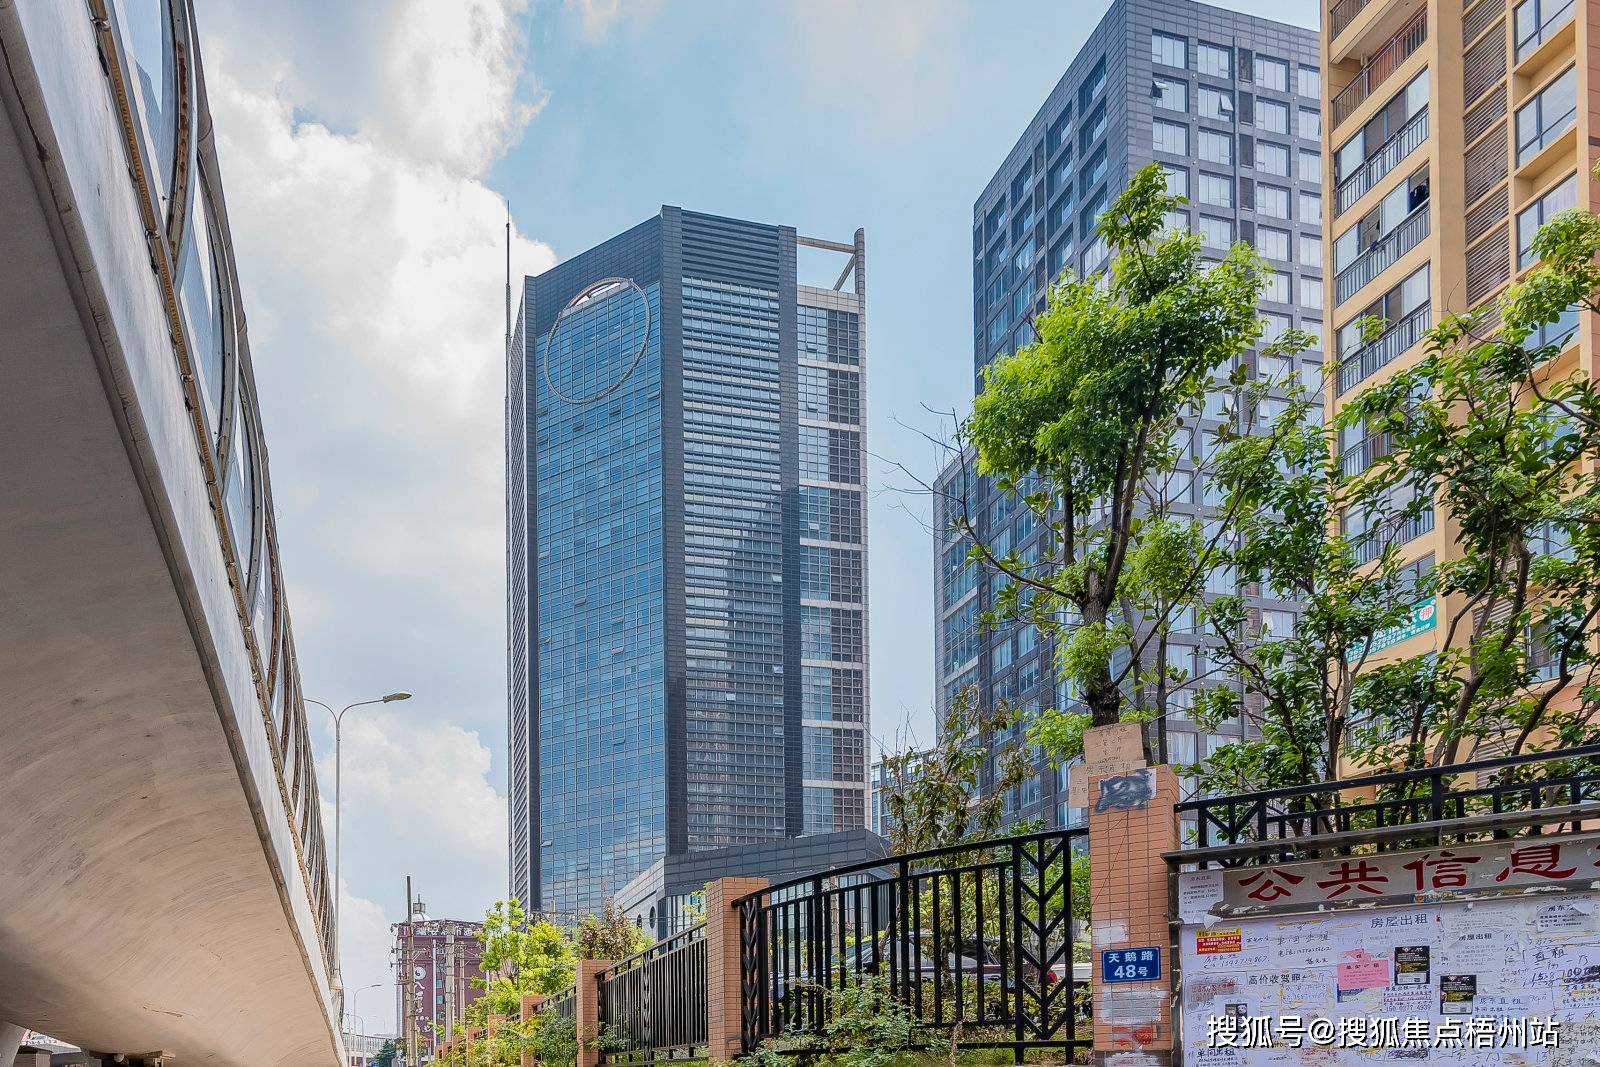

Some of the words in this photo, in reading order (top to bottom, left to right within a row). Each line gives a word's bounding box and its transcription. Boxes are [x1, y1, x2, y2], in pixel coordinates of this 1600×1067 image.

[1238, 844, 1600, 902] 公共信息
[1370, 913, 1428, 929] 房屋出租
[1108, 951, 1153, 963] 天鹅路
[1114, 965, 1148, 978] 48号
